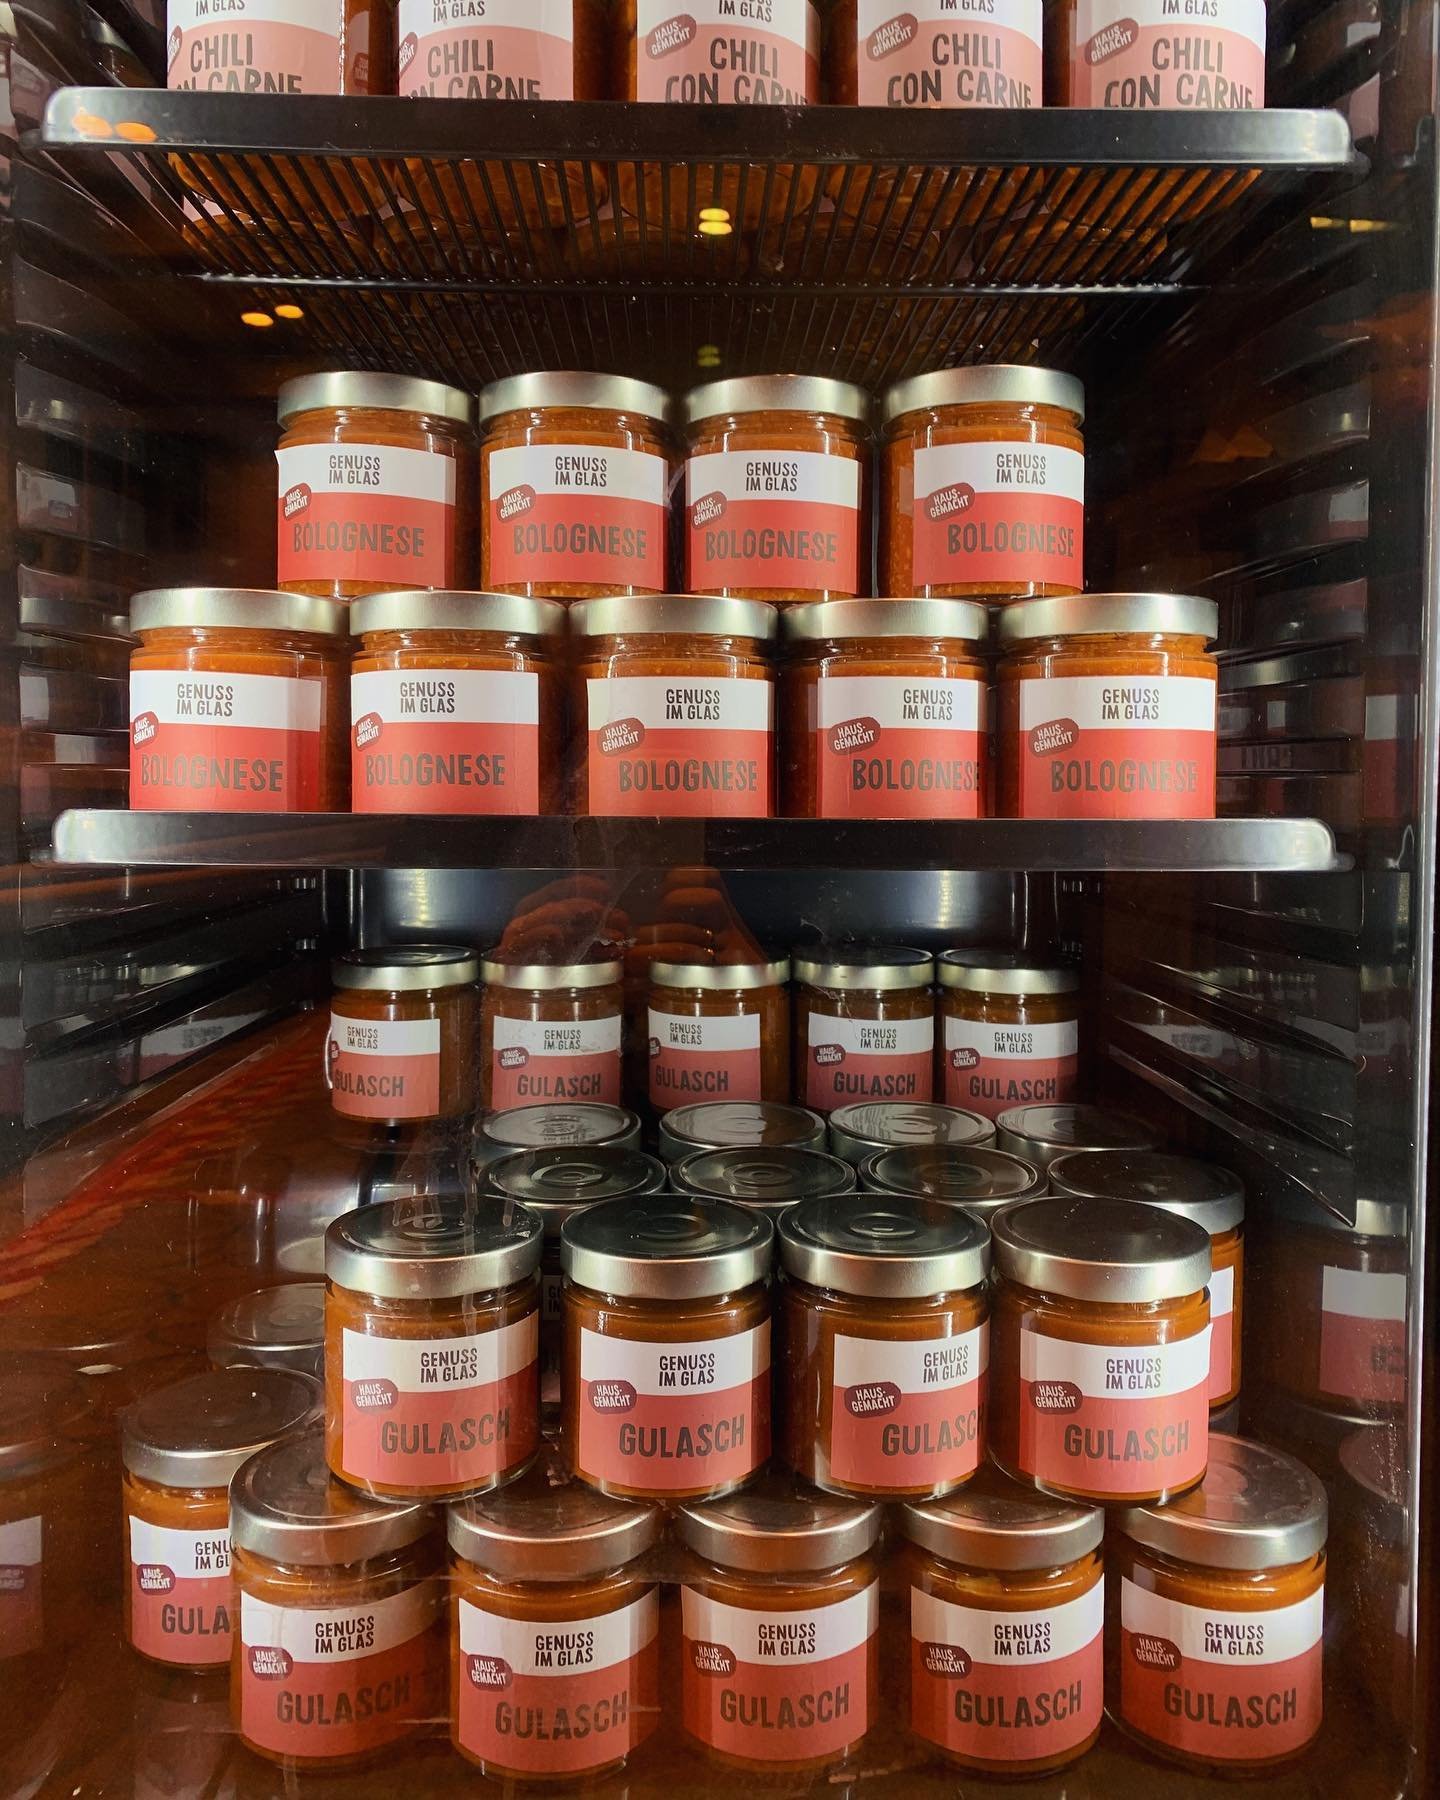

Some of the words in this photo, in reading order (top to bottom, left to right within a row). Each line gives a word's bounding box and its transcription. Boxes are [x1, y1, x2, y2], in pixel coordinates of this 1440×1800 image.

[196, 1, 208, 16] IM
[433, 8, 447, 23] IM
[452, 1, 485, 18] GLAS
[719, 0, 735, 15] IM
[740, 2, 772, 23] GLAS
[962, 0, 994, 13] GLAS
[1163, 0, 1179, 15] IM
[1185, 0, 1218, 16] GLAS
[655, 21, 681, 39] HAUS-
[875, 20, 902, 42] HAUS-
[1094, 25, 1123, 48] HAUS-
[652, 28, 690, 55] GEMACHT
[872, 26, 911, 57] GEMACHT
[1091, 31, 1132, 62] GEMACHT
[190, 33, 252, 72] CHILI
[428, 40, 493, 78] CHILI
[710, 38, 778, 78] CHILI
[932, 34, 1001, 69] CHILI
[1152, 38, 1223, 72] CHILI
[666, 73, 719, 103] CON
[888, 70, 941, 106] CON
[957, 69, 1031, 108] CARNE
[1104, 74, 1161, 108] CON
[330, 455, 380, 470] GENUSS
[555, 456, 607, 472] GENUSS
[746, 462, 798, 476] GENUSS
[997, 454, 1046, 470] GENUSS
[329, 470, 343, 484] IM
[348, 470, 380, 485] GLAS
[555, 471, 570, 485] IM
[575, 472, 607, 487] GLAS
[746, 477, 761, 491] IM
[765, 477, 797, 492] GLAS
[996, 469, 1012, 483] IM
[1017, 470, 1046, 485] GLAS
[502, 490, 524, 506] HAUS-
[934, 488, 961, 505] HAUS-
[500, 497, 531, 519] GEMACHT
[930, 495, 969, 518] GEMACHT
[294, 521, 425, 557] BOLOGNESE
[513, 523, 647, 559] BOLOGNESE
[706, 528, 838, 562] BOLOGNESE
[948, 522, 1074, 558] BOLOGNESE
[178, 684, 233, 700] GENUSS
[400, 682, 455, 697] GENUSS
[666, 689, 720, 704] GENUSS
[903, 689, 952, 704] GENUSS
[1103, 689, 1159, 704] GENUSS
[177, 700, 192, 715] IM
[197, 700, 232, 717] GLAS
[400, 698, 415, 713] IM
[420, 698, 455, 713] GLAS
[666, 705, 683, 720] IM
[688, 705, 720, 720] GLAS
[903, 705, 919, 720] IM
[924, 705, 952, 720] GLAS
[1102, 704, 1119, 720] IM
[1125, 704, 1159, 720] GLAS
[605, 723, 631, 740] HAUS-
[838, 722, 866, 737] HAUS-
[1037, 724, 1064, 740] HAUS-
[602, 731, 639, 752] GEMACHT
[834, 730, 874, 750] GEMACHT
[1033, 732, 1073, 753] GEMACHT
[141, 753, 283, 792] BOLOGNESE
[366, 754, 505, 786] BOLOGNESE
[619, 759, 757, 792] BOLOGNESE
[853, 759, 979, 791] BOLOGNESE
[1051, 760, 1198, 792] BOLOGNESE
[348, 1026, 378, 1038] GENUSS
[545, 1030, 581, 1040] GENUSS
[670, 1023, 702, 1034] GENUSS
[861, 1028, 896, 1038] GENUSS
[994, 1032, 1032, 1042] GENUSS
[348, 1037, 355, 1047] IM
[358, 1039, 378, 1049] GLAS
[544, 1041, 555, 1050] IM
[558, 1041, 580, 1050] GLAS
[670, 1034, 678, 1043] IM
[681, 1034, 702, 1045] GLAS
[860, 1039, 871, 1049] IM
[875, 1039, 896, 1049] GLAS
[994, 1043, 1006, 1053] IM
[1009, 1043, 1032, 1053] GLAS
[335, 1069, 404, 1097] GULASCH
[517, 1073, 601, 1097] GULASCH
[656, 1065, 728, 1092] GULASCH
[834, 1072, 915, 1096] GULASCH
[970, 1076, 1056, 1100] GULASCH
[421, 1348, 477, 1368] GENUSS
[660, 1353, 715, 1370] GENUSS
[924, 1345, 968, 1367] GENUSS
[421, 1368, 438, 1383] IM
[443, 1363, 477, 1381] GLAS
[923, 1368, 938, 1383] IM
[942, 1361, 967, 1380] GLAS
[1106, 1358, 1161, 1374] GENUSS
[659, 1372, 675, 1386] IM
[681, 1369, 714, 1386] GLAS
[1106, 1374, 1123, 1389] IM
[1128, 1374, 1161, 1389] GLAS
[359, 1383, 384, 1394] HAUS-
[597, 1385, 622, 1395] HAUS-
[856, 1387, 886, 1399] HAUS-
[1039, 1385, 1067, 1397] HAUS-
[356, 1393, 392, 1407] GEMACHT
[594, 1395, 630, 1407] GEMACHT
[852, 1396, 895, 1413] GEMACHT
[1036, 1396, 1076, 1409] GEMACHT
[382, 1408, 510, 1454] GULASCH
[619, 1414, 745, 1458] GULASCH
[1064, 1421, 1189, 1461] GULASCH
[195, 1557, 211, 1569] IM
[162, 1604, 229, 1634] GULA
[316, 1616, 374, 1637] GENUSS
[759, 1623, 816, 1639] GENUSS
[995, 1622, 1050, 1639] GENUSS
[1205, 1622, 1264, 1640] GENUSS
[315, 1638, 333, 1653] IM
[338, 1631, 374, 1652] GLAS
[536, 1632, 593, 1650] GENUSS
[759, 1640, 775, 1656] IM
[780, 1639, 815, 1656] GLAS
[995, 1640, 1012, 1655] IM
[1017, 1638, 1050, 1655] GLAS
[1139, 1638, 1166, 1651] HAUS-
[1205, 1638, 1222, 1654] IM
[1228, 1641, 1263, 1656] GLAS
[255, 1651, 278, 1663] HAUS-
[535, 1651, 552, 1666] IM
[558, 1648, 593, 1666] GLAS
[698, 1645, 722, 1659] HAUS-
[930, 1647, 957, 1661] HAUS-
[1136, 1648, 1175, 1667] GEMACHT
[253, 1661, 287, 1674] GEMACHT
[474, 1659, 498, 1673] HAUS-
[696, 1656, 730, 1672] GEMACHT
[926, 1658, 965, 1673] GEMACHT
[472, 1670, 506, 1684] GEMACHT
[277, 1673, 410, 1725] GULASCH
[720, 1682, 849, 1729] GULASCH
[955, 1680, 1081, 1728] GULASCH
[1165, 1682, 1296, 1728] GULASCH
[496, 1691, 627, 1740] GULASCH
